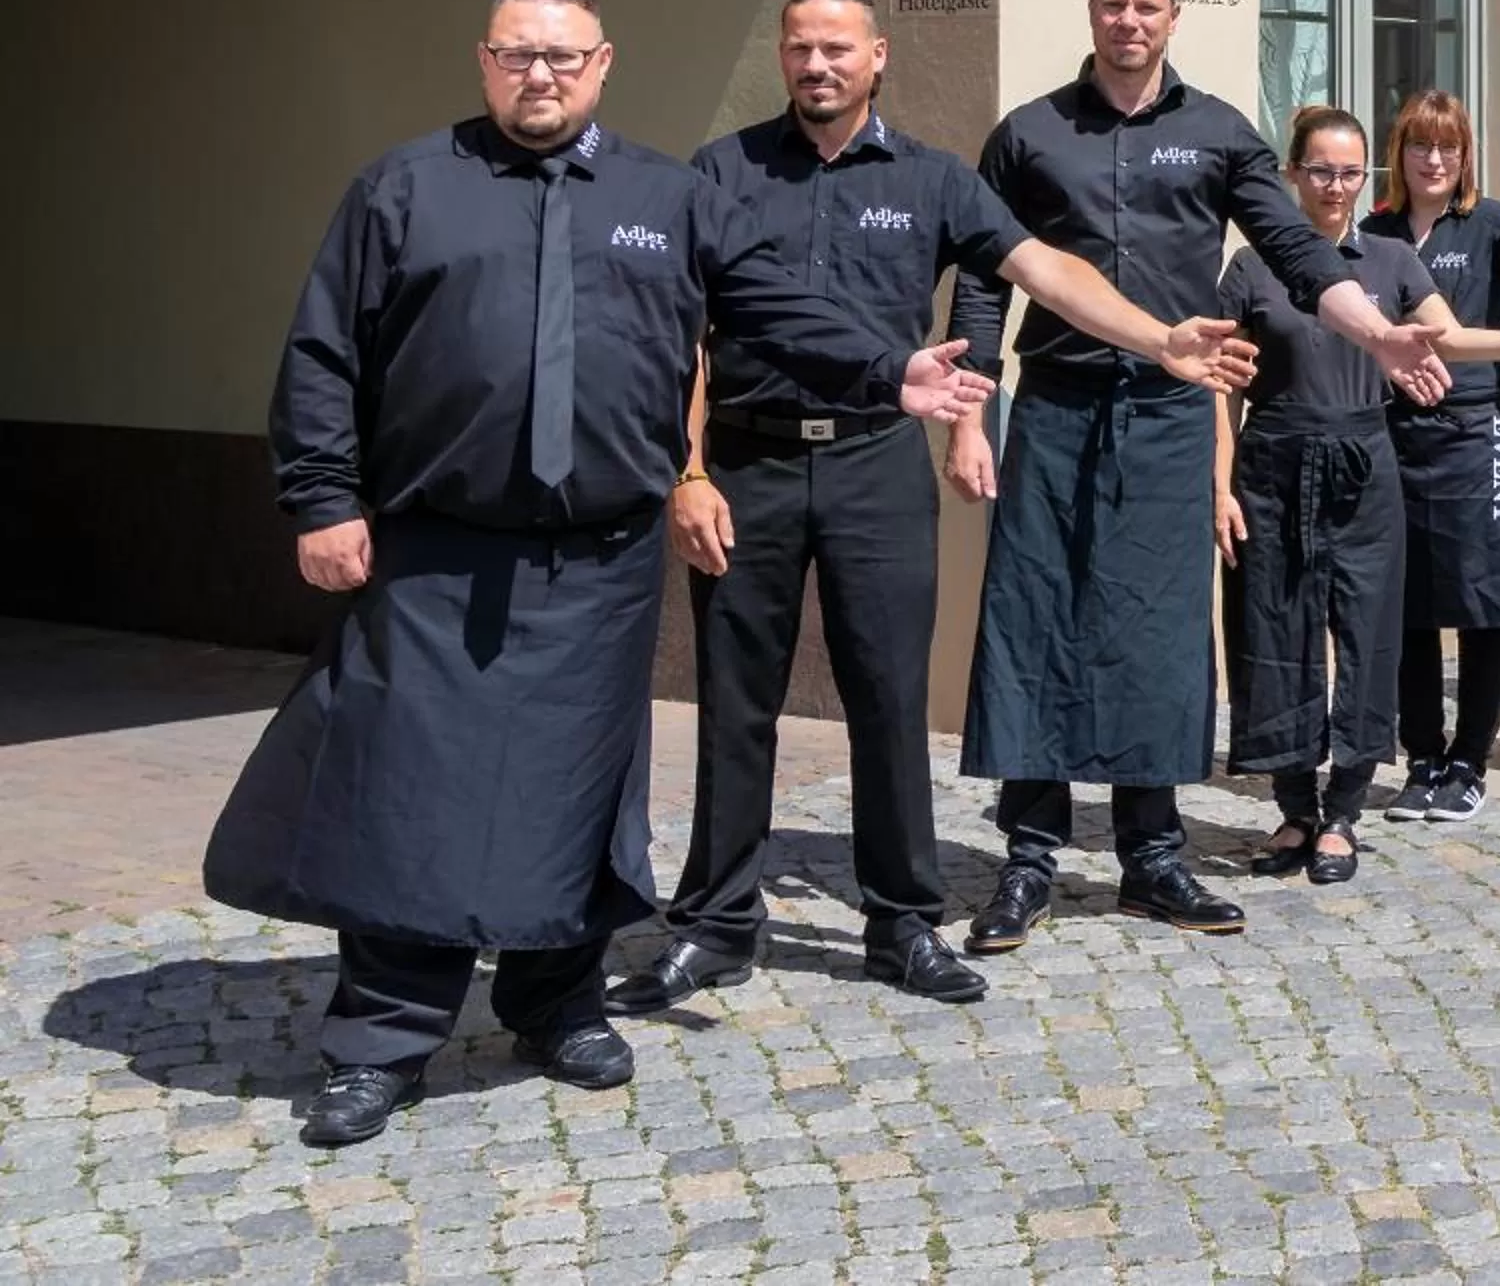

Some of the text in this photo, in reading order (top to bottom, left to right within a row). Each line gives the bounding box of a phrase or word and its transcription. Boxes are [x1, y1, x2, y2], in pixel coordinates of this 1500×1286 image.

[1151, 147, 1198, 159] Adler
[860, 206, 912, 222] Adler
[613, 225, 667, 245] Adler
